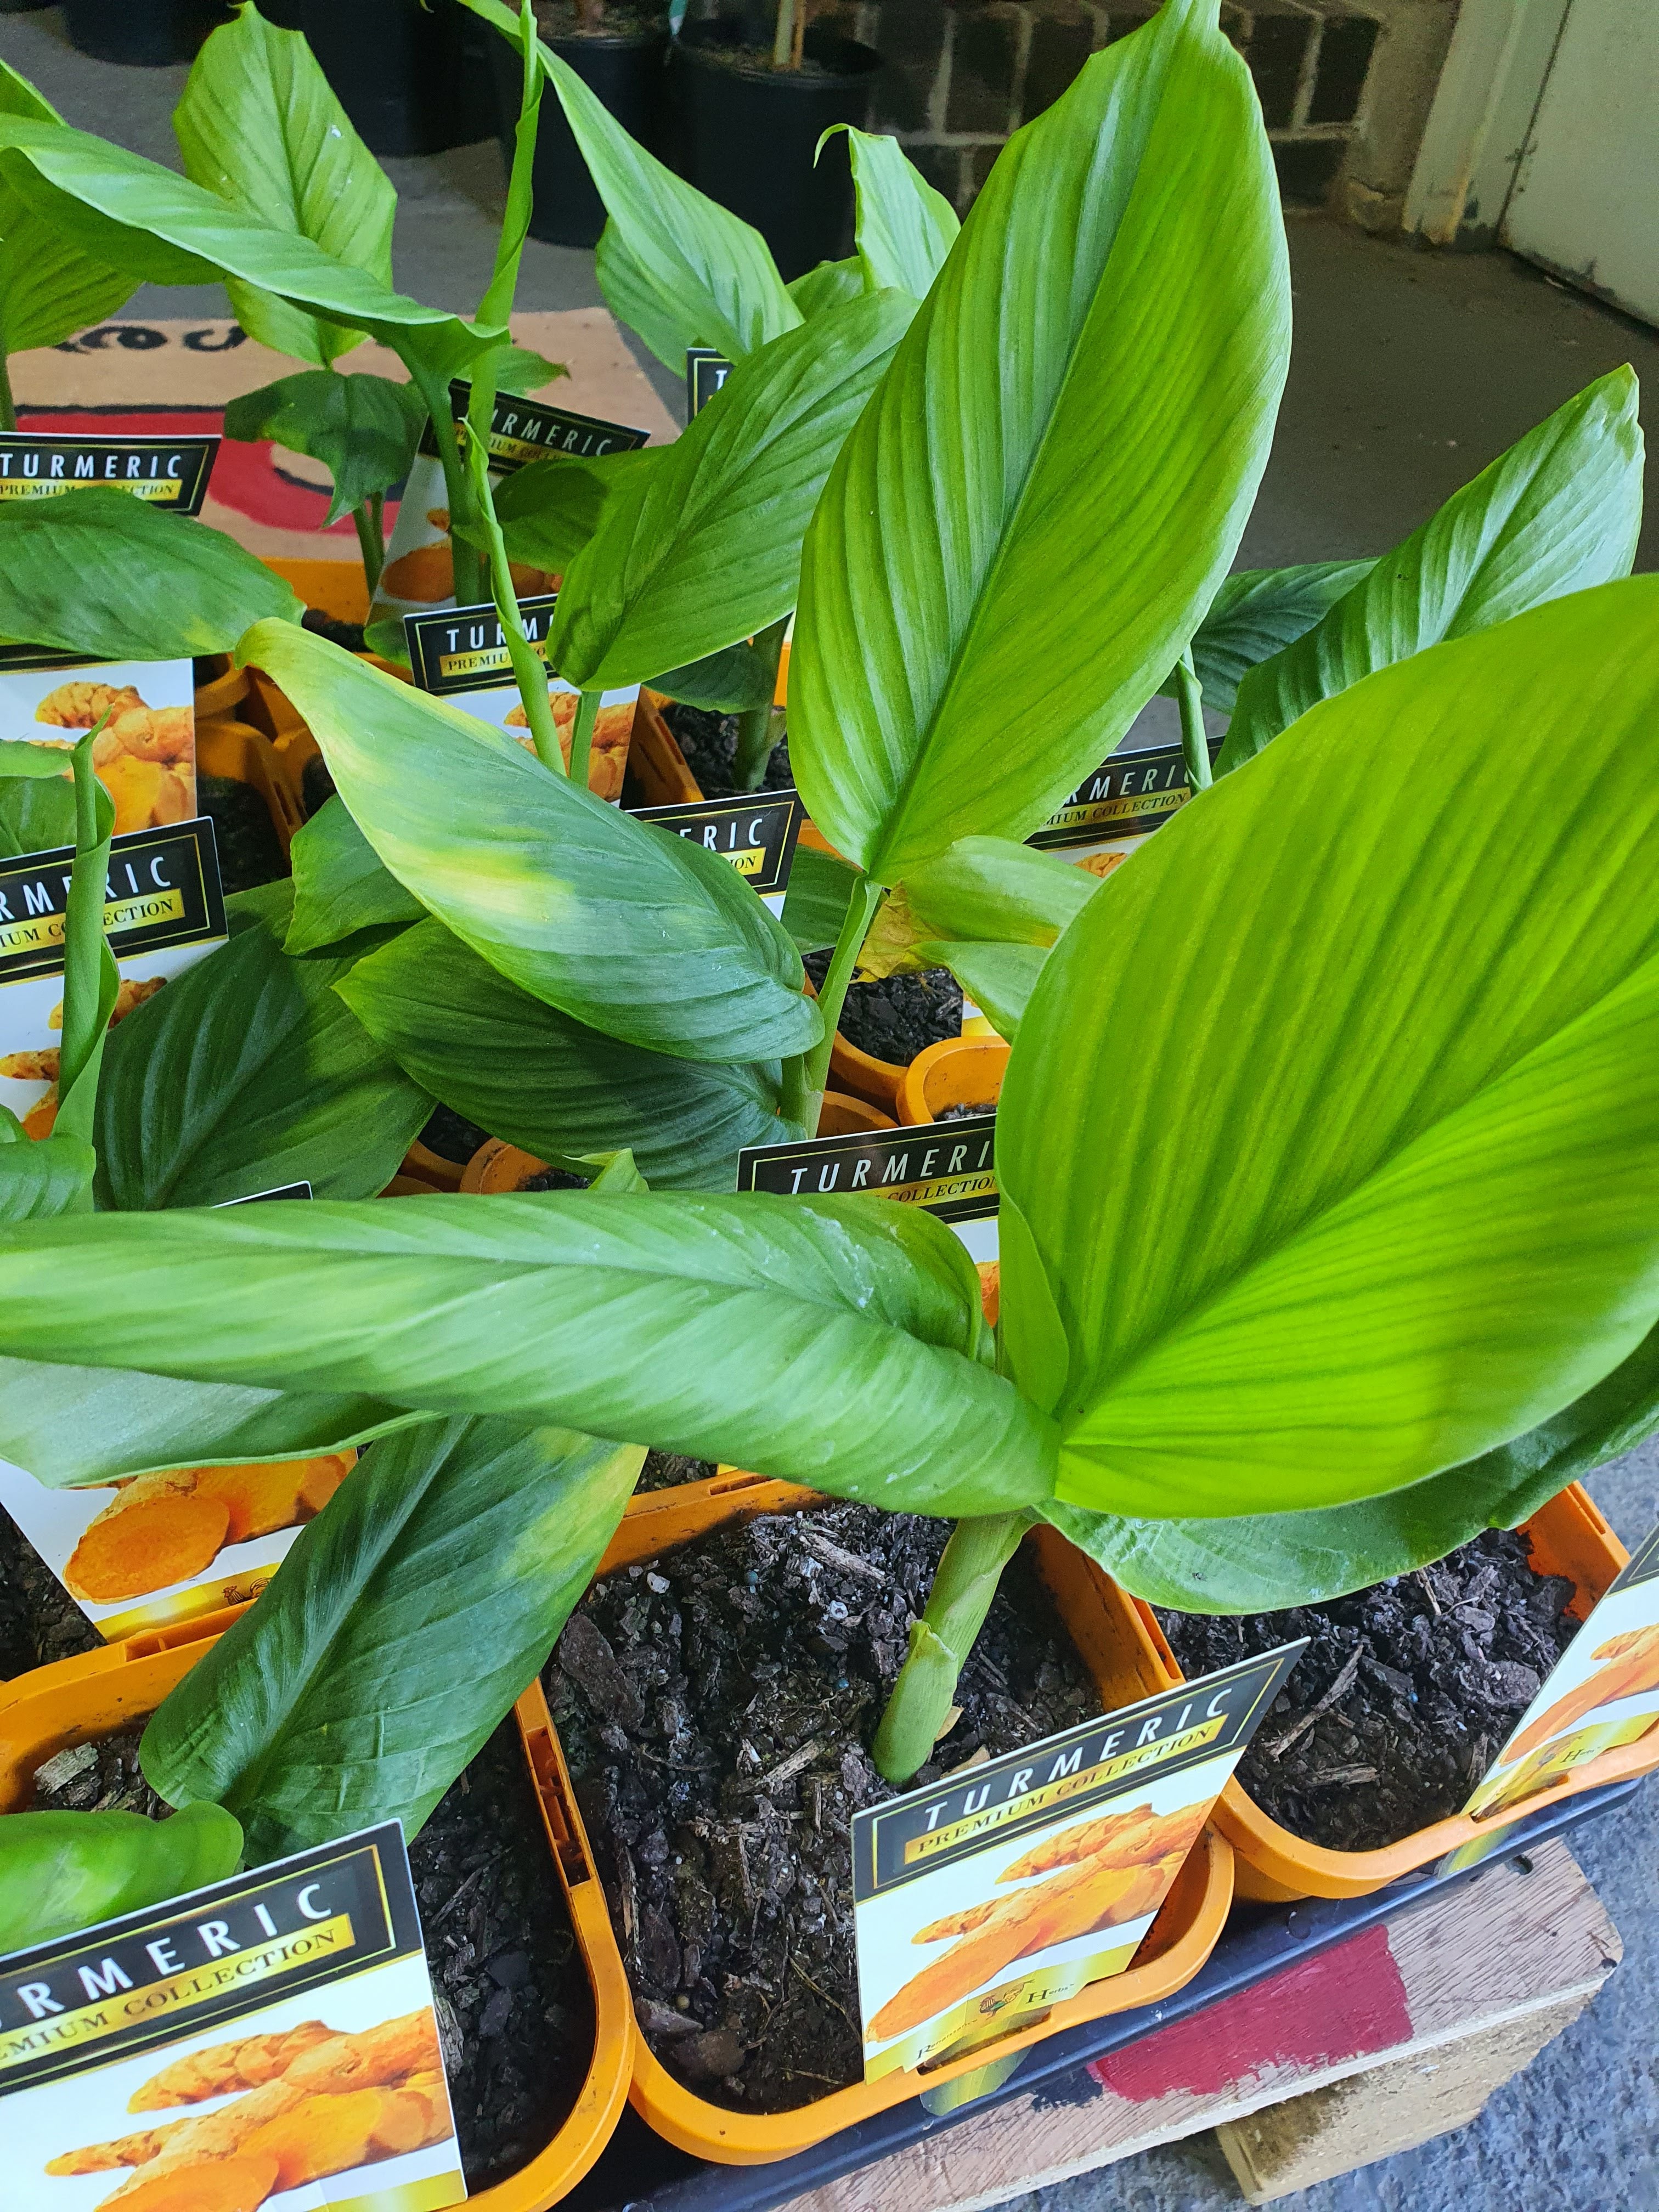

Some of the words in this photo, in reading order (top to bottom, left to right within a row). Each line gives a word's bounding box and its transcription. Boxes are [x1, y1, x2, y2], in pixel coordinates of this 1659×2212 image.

[0, 453, 182, 478] TURMERIC
[449, 651, 509, 670] PREMIU
[1092, 792, 1188, 819] COLLECTION
[924, 1688, 1232, 1831] TURMERIC
[918, 1791, 1047, 1854] PREMIUM
[1056, 1725, 1212, 1796] COLLECTION
[124, 1928, 335, 2016] COLLECTION
